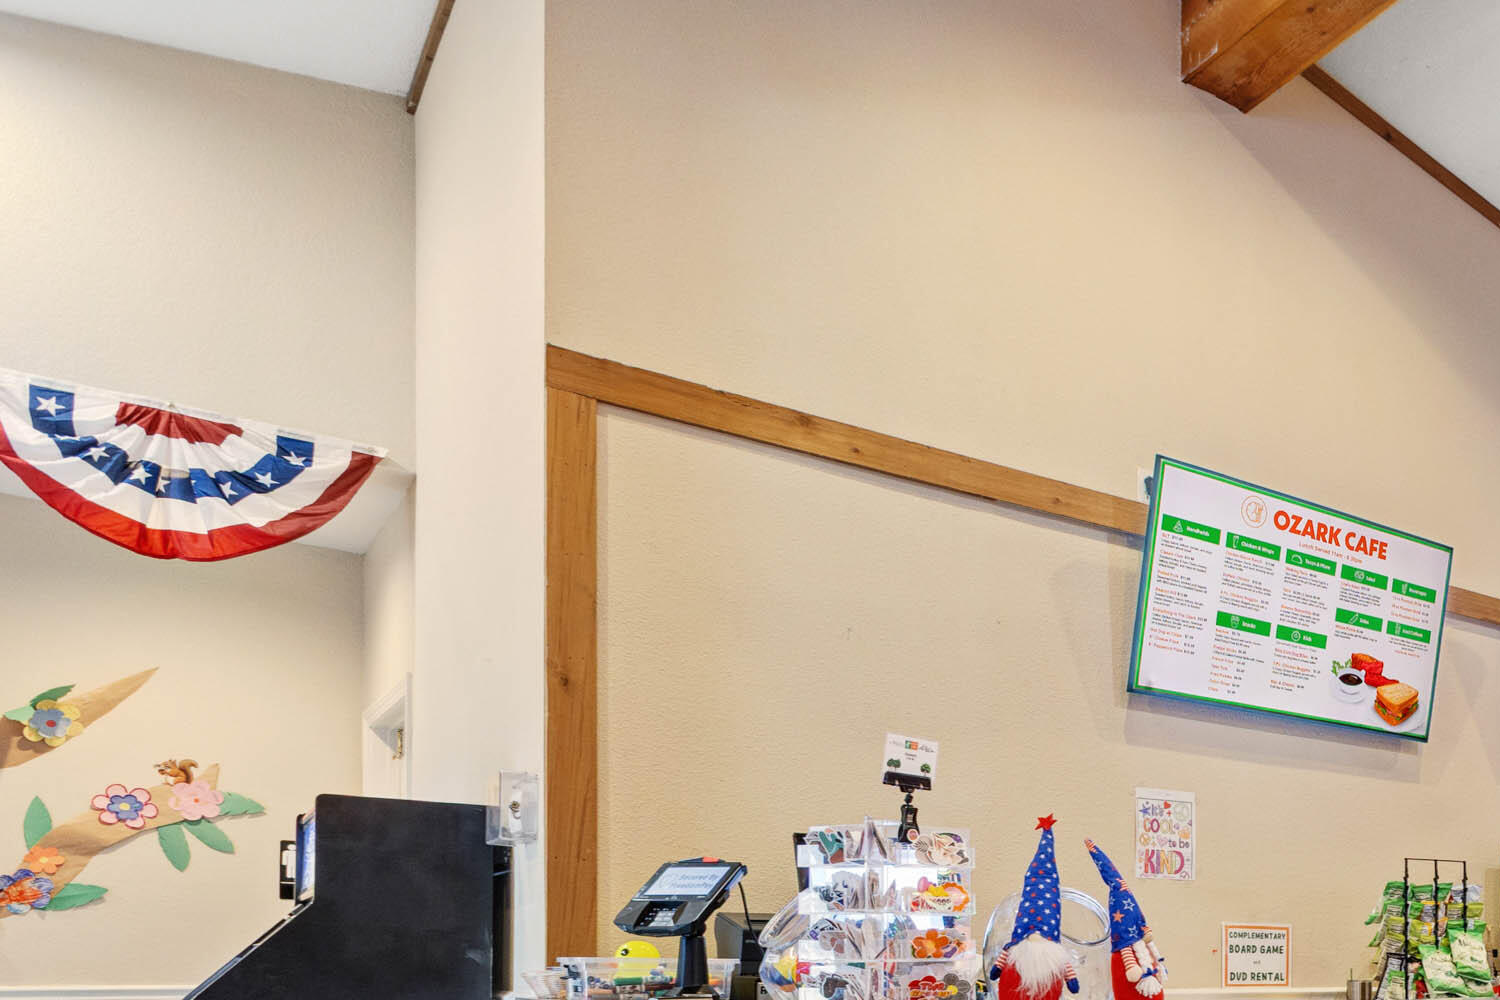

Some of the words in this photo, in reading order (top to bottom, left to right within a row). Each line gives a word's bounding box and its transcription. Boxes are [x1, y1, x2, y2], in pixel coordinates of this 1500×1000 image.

[1273, 510, 1341, 547] OZARK
[1345, 532, 1388, 561] CAFE
[1144, 848, 1185, 875] KIND
[1229, 931, 1286, 940] COMPLEMENTARY
[1229, 944, 1257, 954] BOARD
[1260, 945, 1285, 954] GAME
[1230, 972, 1248, 981] DVD
[1250, 972, 1285, 981] RENTAL
